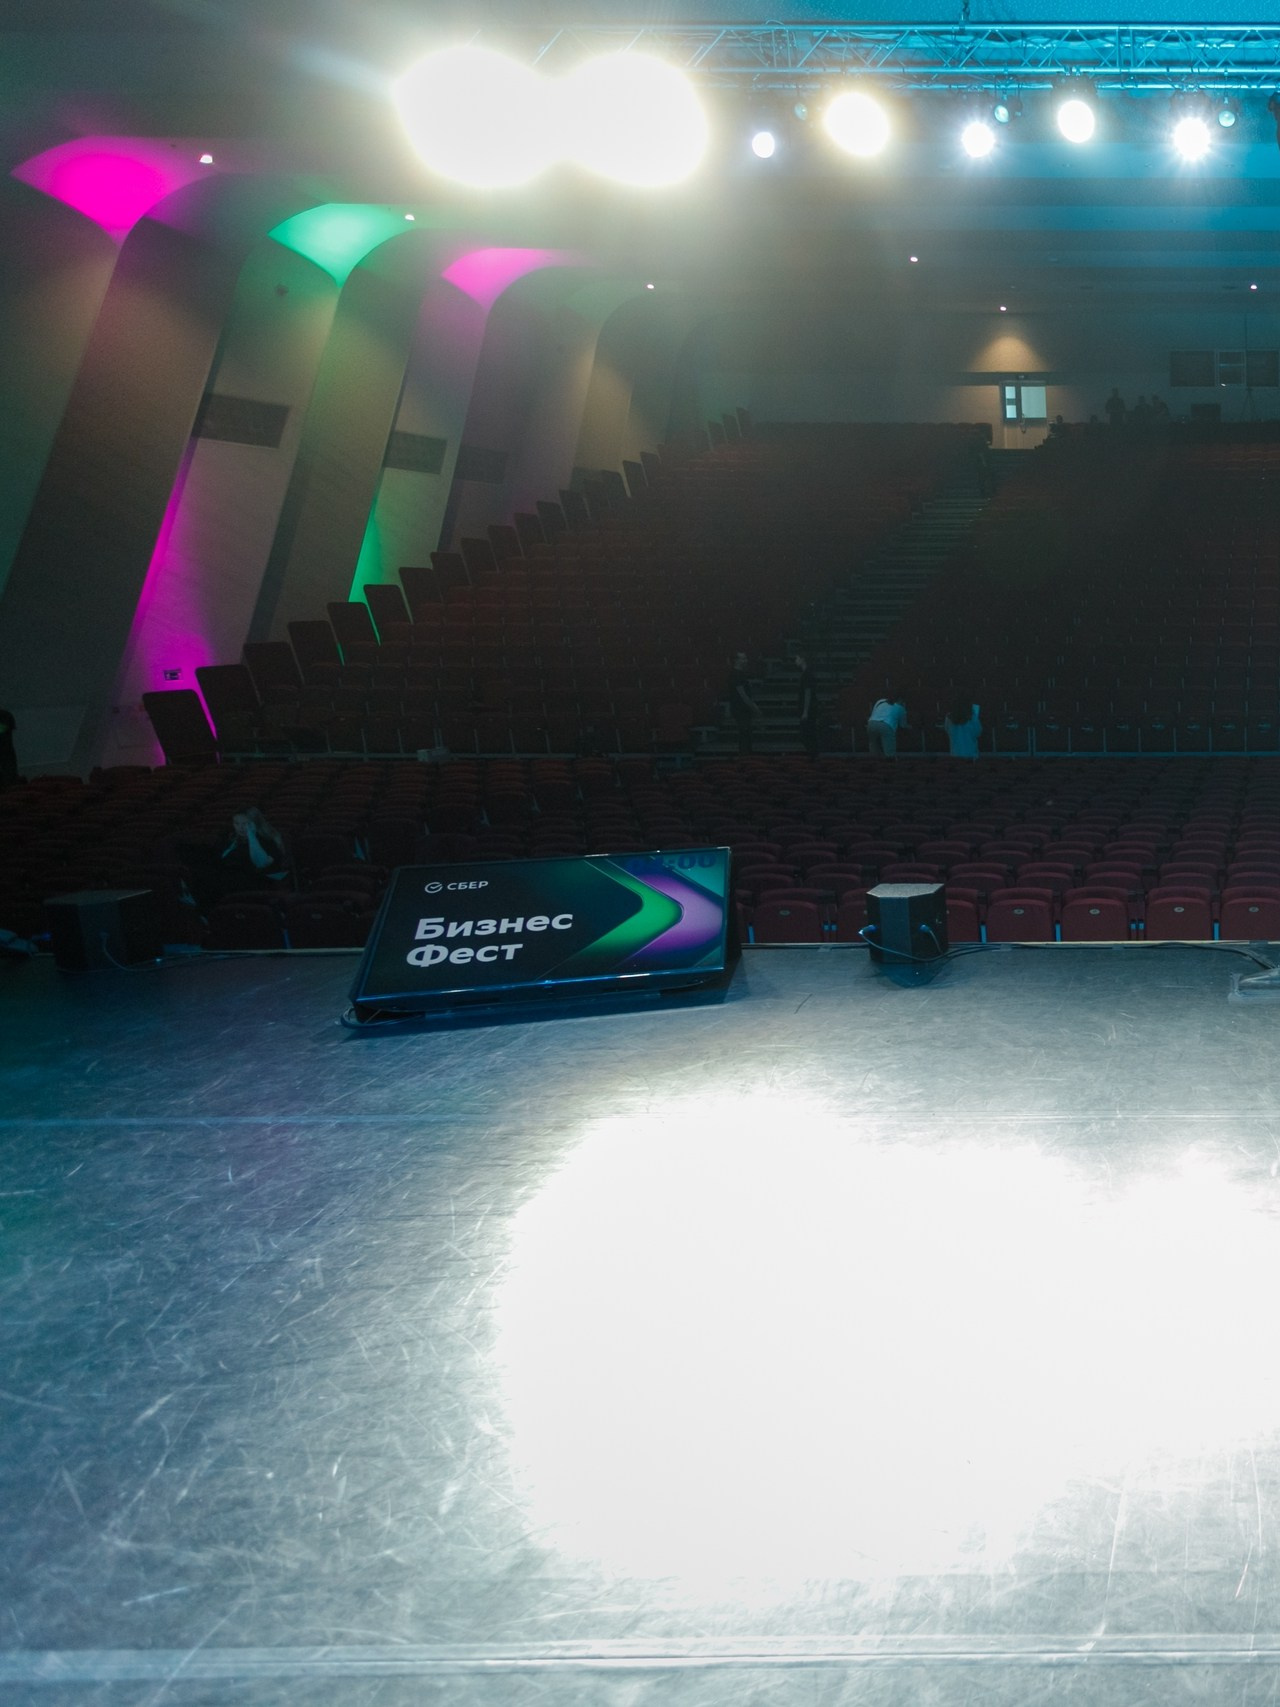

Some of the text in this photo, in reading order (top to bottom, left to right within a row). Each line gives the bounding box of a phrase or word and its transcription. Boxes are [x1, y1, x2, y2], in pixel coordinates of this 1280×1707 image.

[446, 880, 489, 891] СБЕР
[414, 913, 574, 940] Бизнес
[406, 943, 524, 968] Фест
